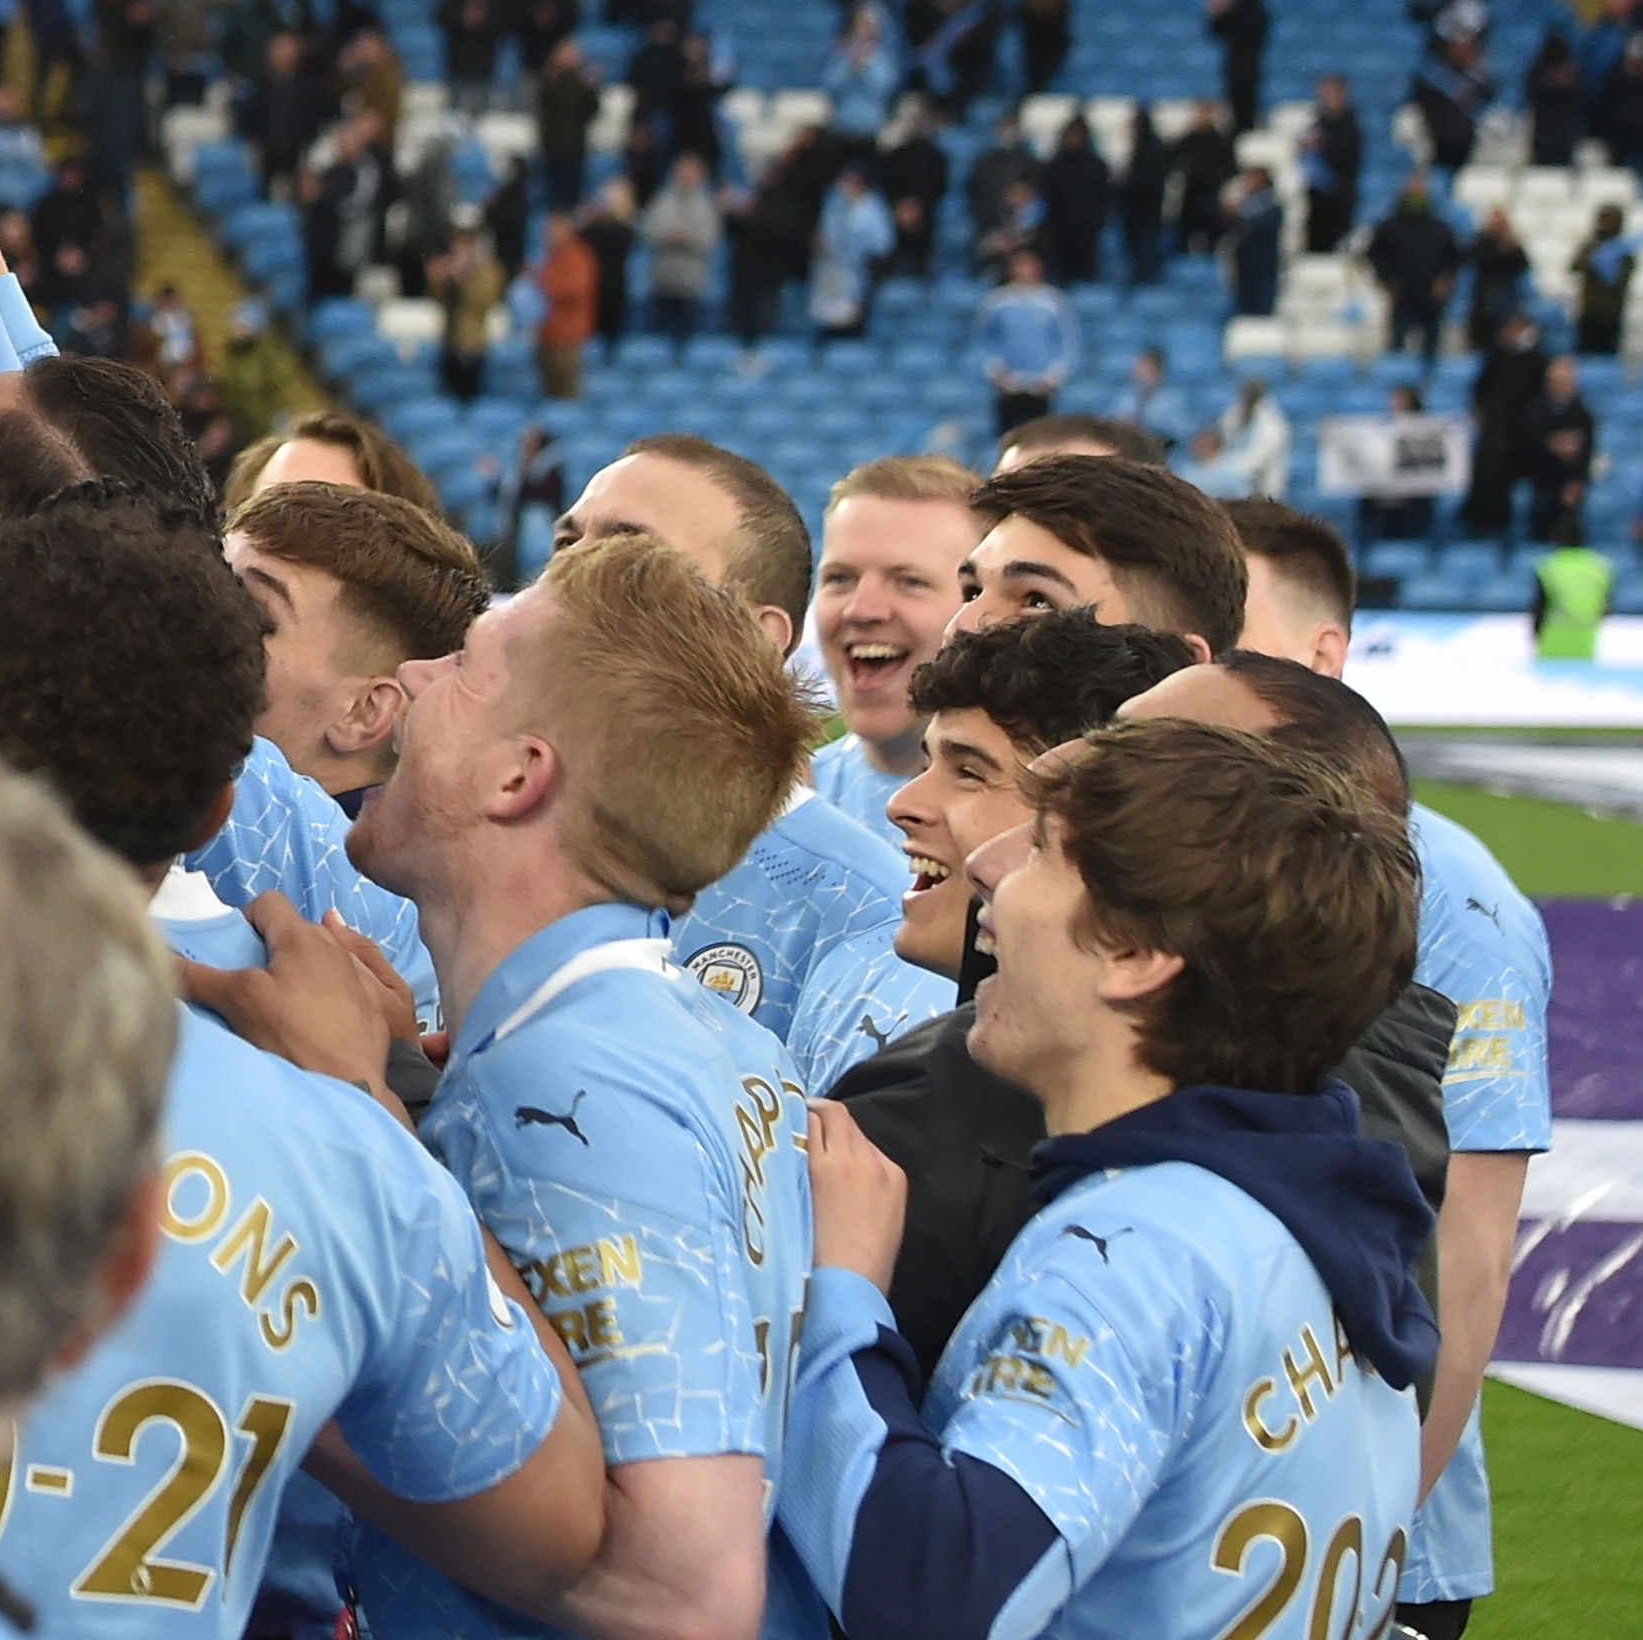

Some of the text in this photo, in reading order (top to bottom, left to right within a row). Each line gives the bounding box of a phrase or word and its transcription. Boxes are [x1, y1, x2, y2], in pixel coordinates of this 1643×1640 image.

[691, 948, 758, 981] MANCHESTER
[1455, 1001, 1527, 1032] XEN
[1448, 1037, 1513, 1068] IRE
[157, 1149, 322, 1354] ONS
[548, 1294, 625, 1353] RE
